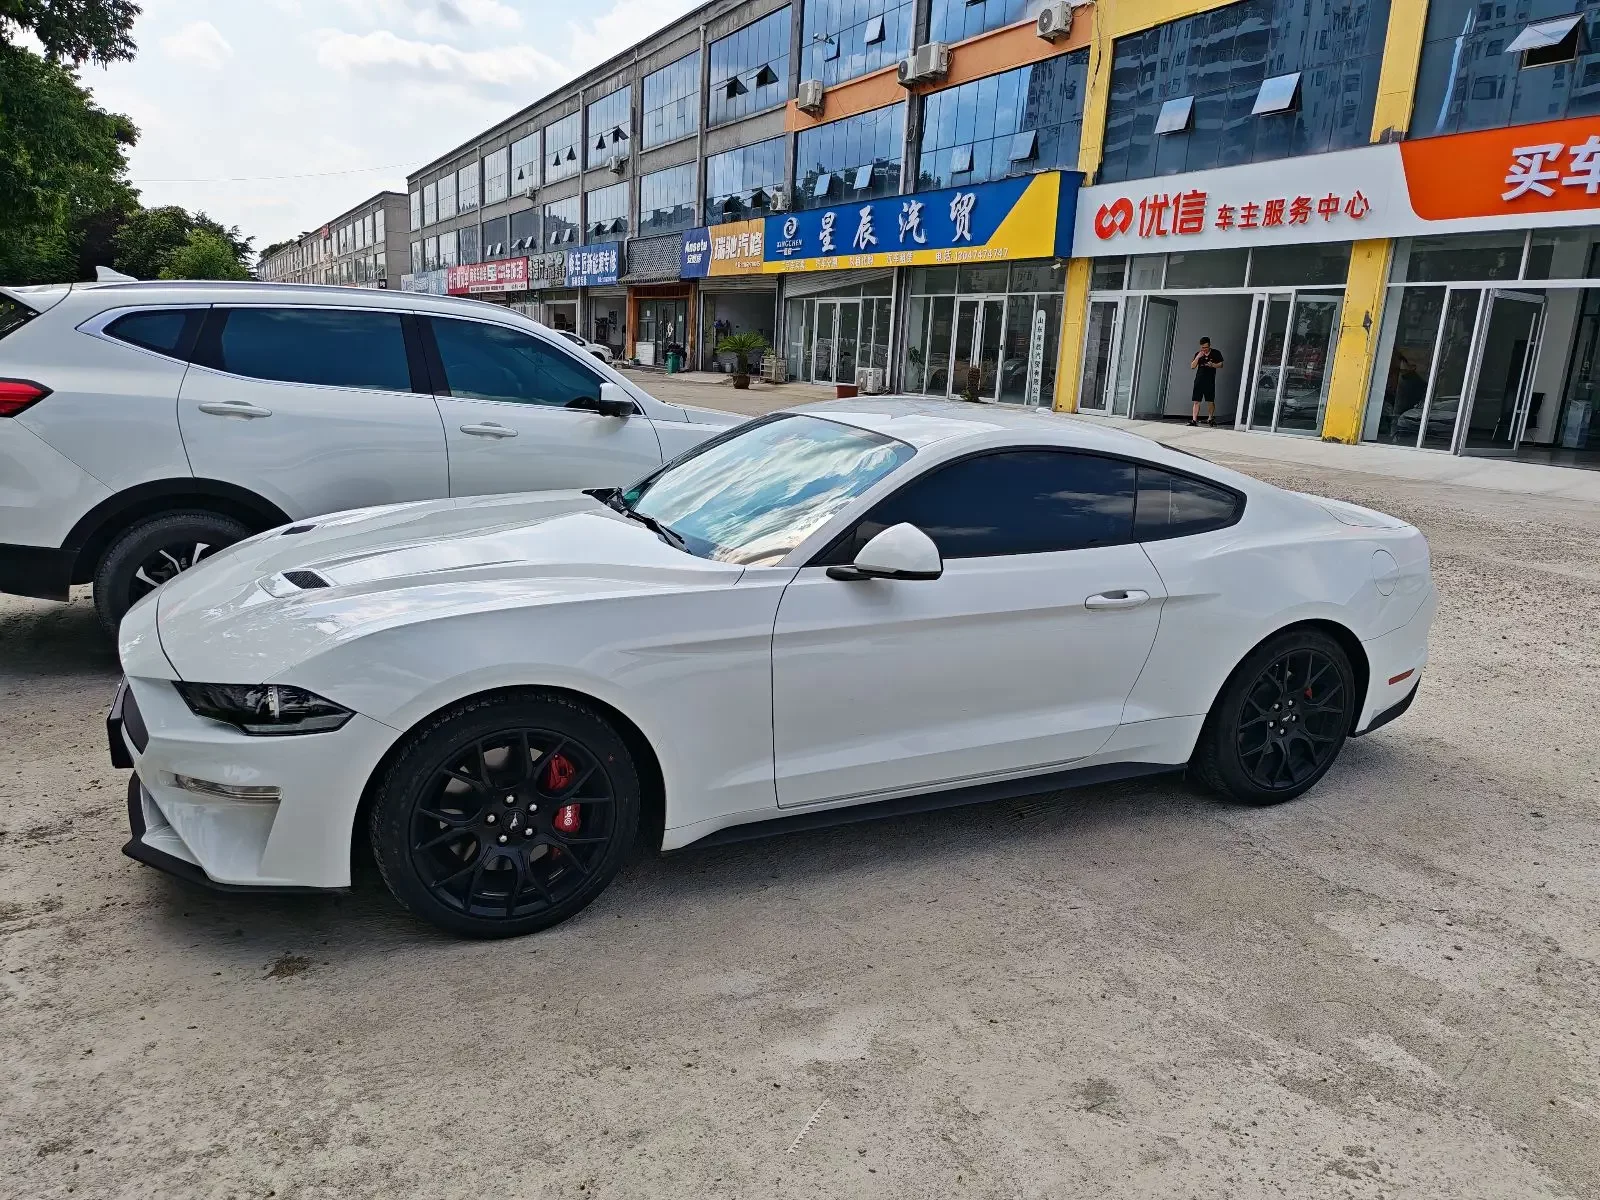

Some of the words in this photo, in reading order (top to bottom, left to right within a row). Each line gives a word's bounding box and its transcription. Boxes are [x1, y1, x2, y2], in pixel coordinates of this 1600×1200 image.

[819, 191, 977, 253] 星辰汽贸
[1138, 189, 1207, 237] 优信
[1214, 189, 1370, 231] 车主服务中心
